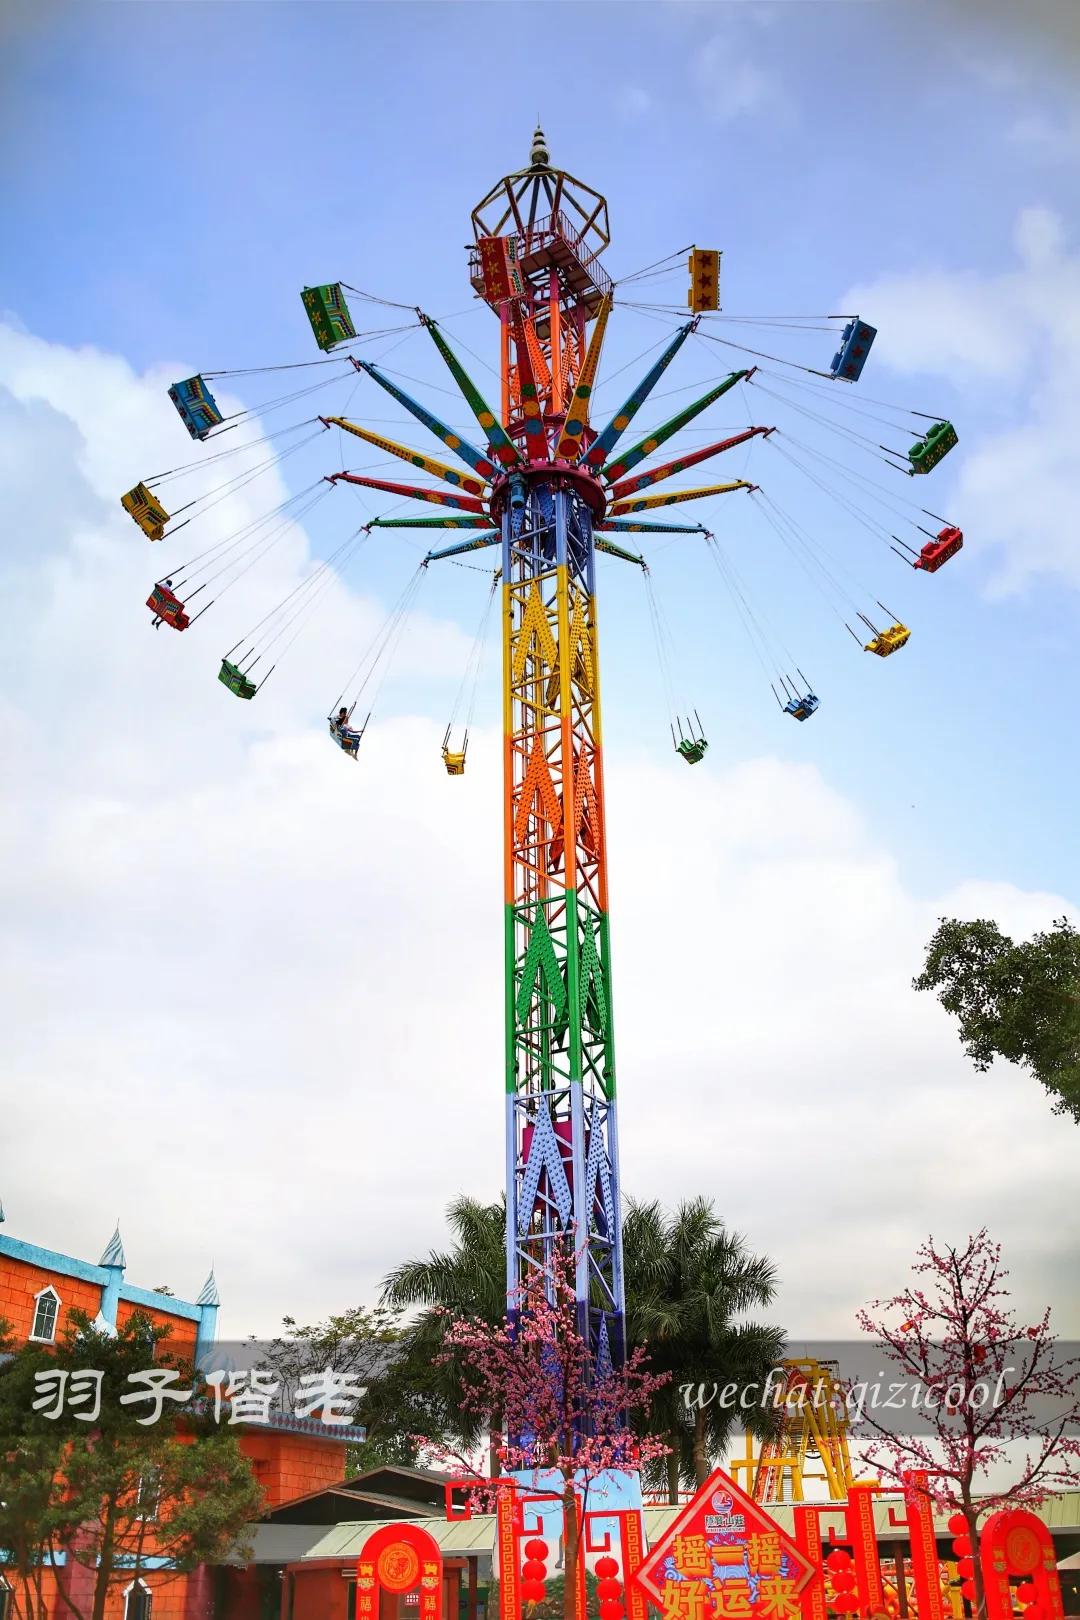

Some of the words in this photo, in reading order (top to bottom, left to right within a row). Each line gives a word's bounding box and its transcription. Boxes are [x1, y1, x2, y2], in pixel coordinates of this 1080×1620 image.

[672, 1531, 783, 1569] 摇一摇
[660, 1575, 801, 1620] 好运来
